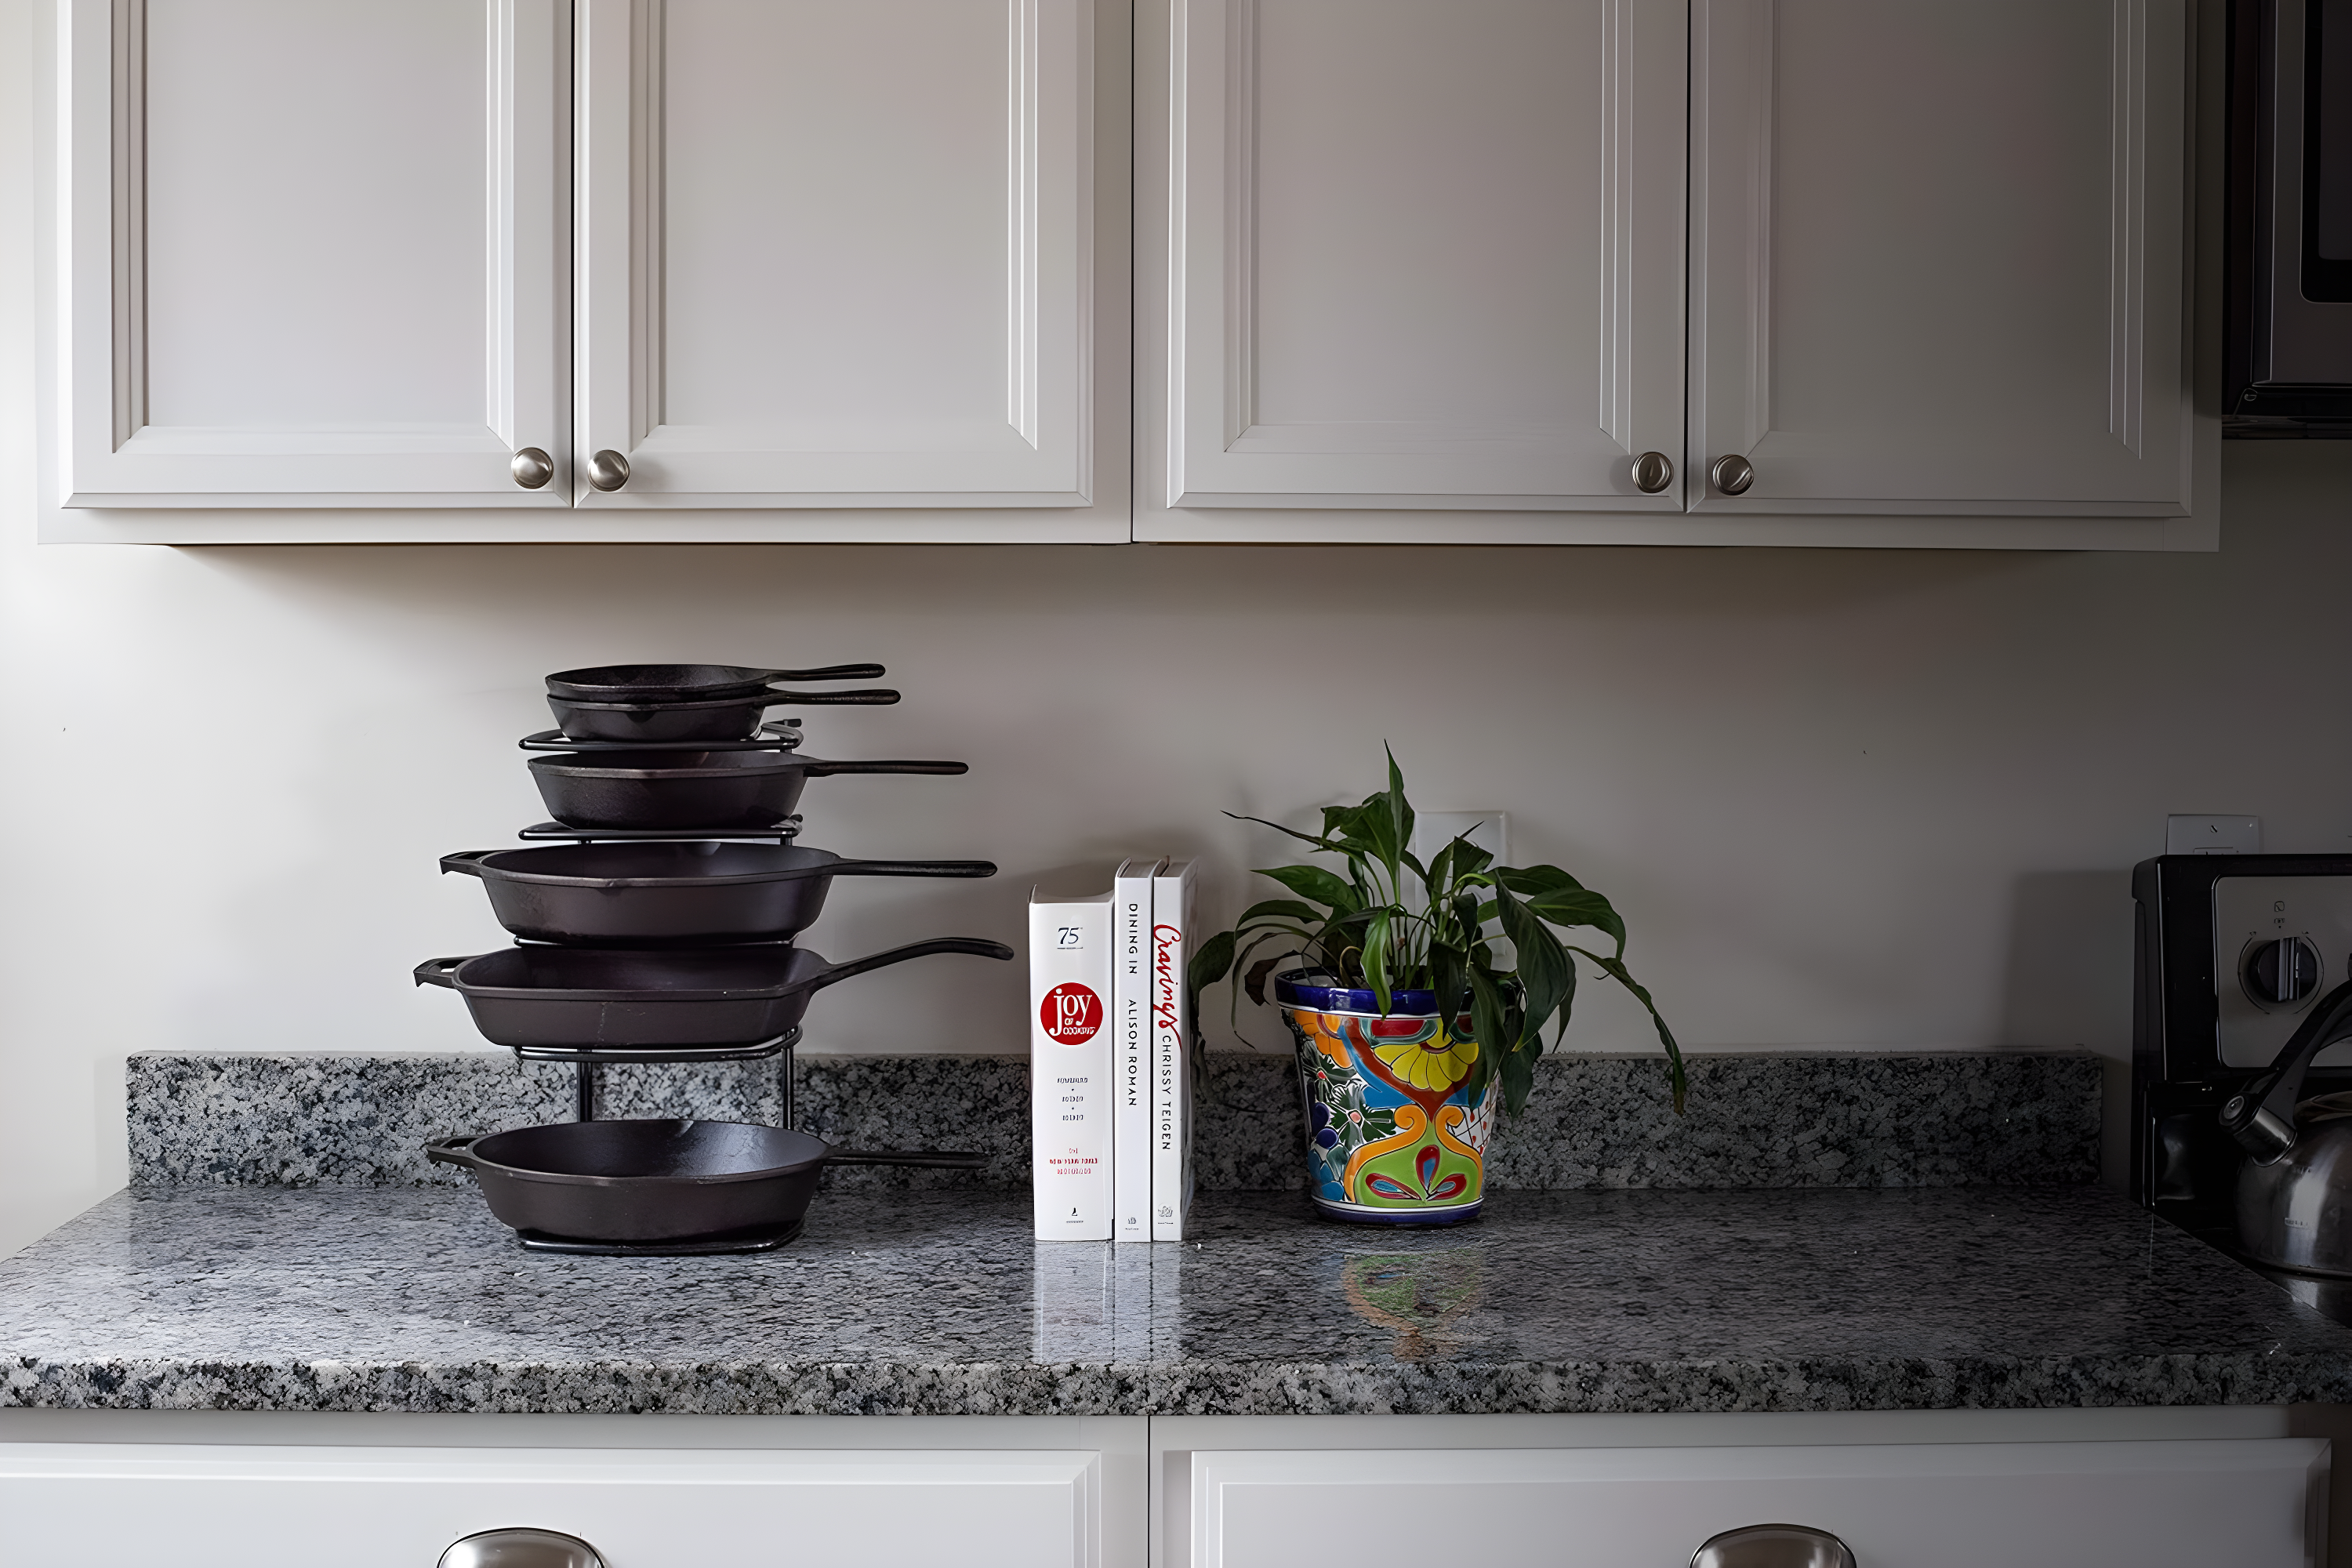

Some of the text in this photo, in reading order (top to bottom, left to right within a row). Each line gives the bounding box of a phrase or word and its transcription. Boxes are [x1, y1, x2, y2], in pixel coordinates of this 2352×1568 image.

[1058, 927, 1080, 945] 75
[1128, 903, 1138, 975] DINING IN
[1048, 988, 1092, 1036] joy
[1153, 924, 1182, 1054] Cravings
[1127, 999, 1138, 1106] ALISON ROMAN
[1161, 1035, 1172, 1150] CHRISSY TEIGEN
